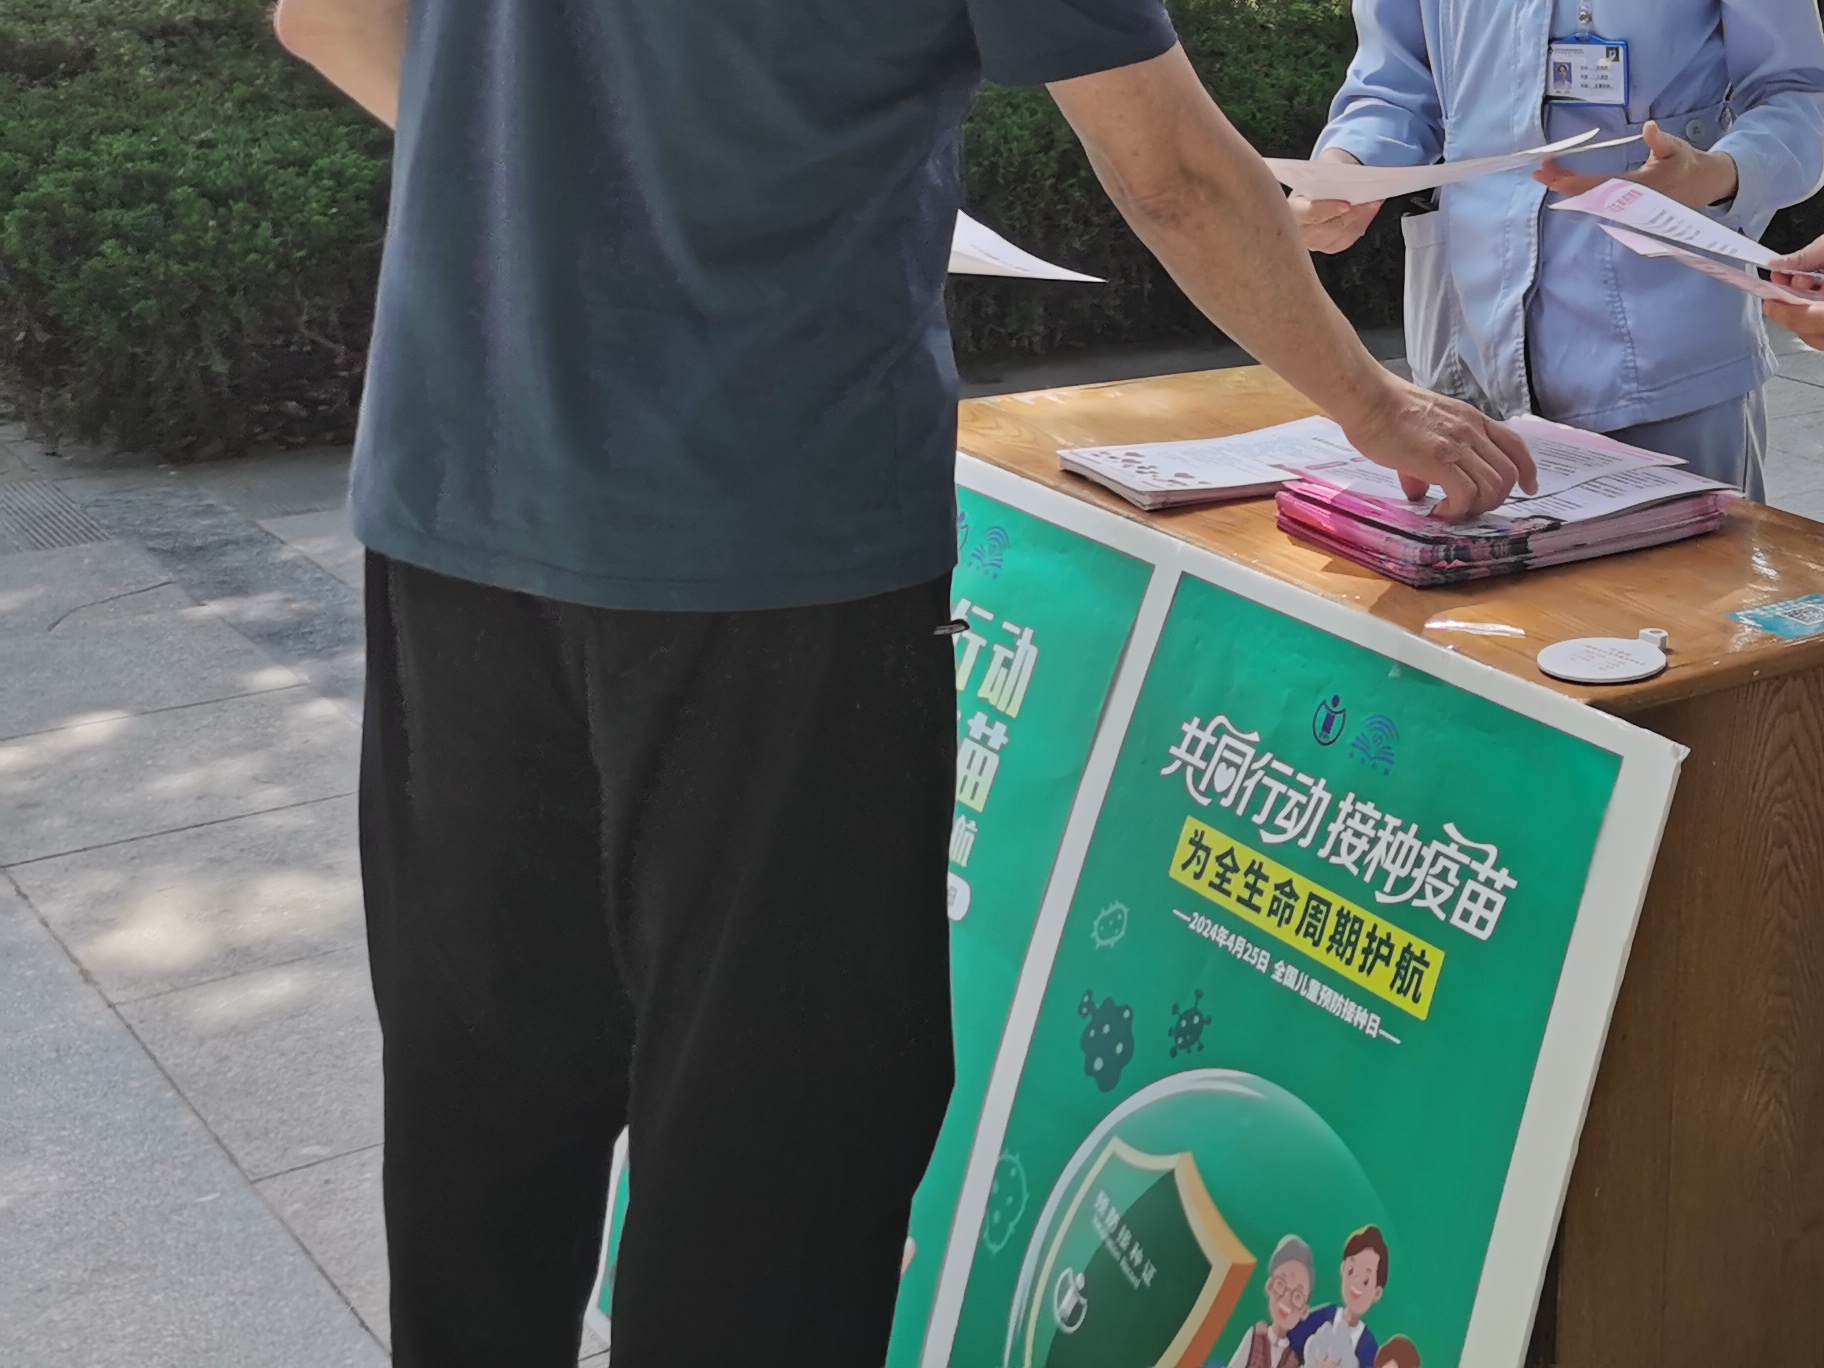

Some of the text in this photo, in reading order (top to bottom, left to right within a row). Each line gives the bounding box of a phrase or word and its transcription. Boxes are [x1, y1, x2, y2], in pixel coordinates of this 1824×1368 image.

[1160, 714, 1519, 942] 共同行动 接种疫苗
[1180, 828, 1431, 1006] 为全生命周期护航
